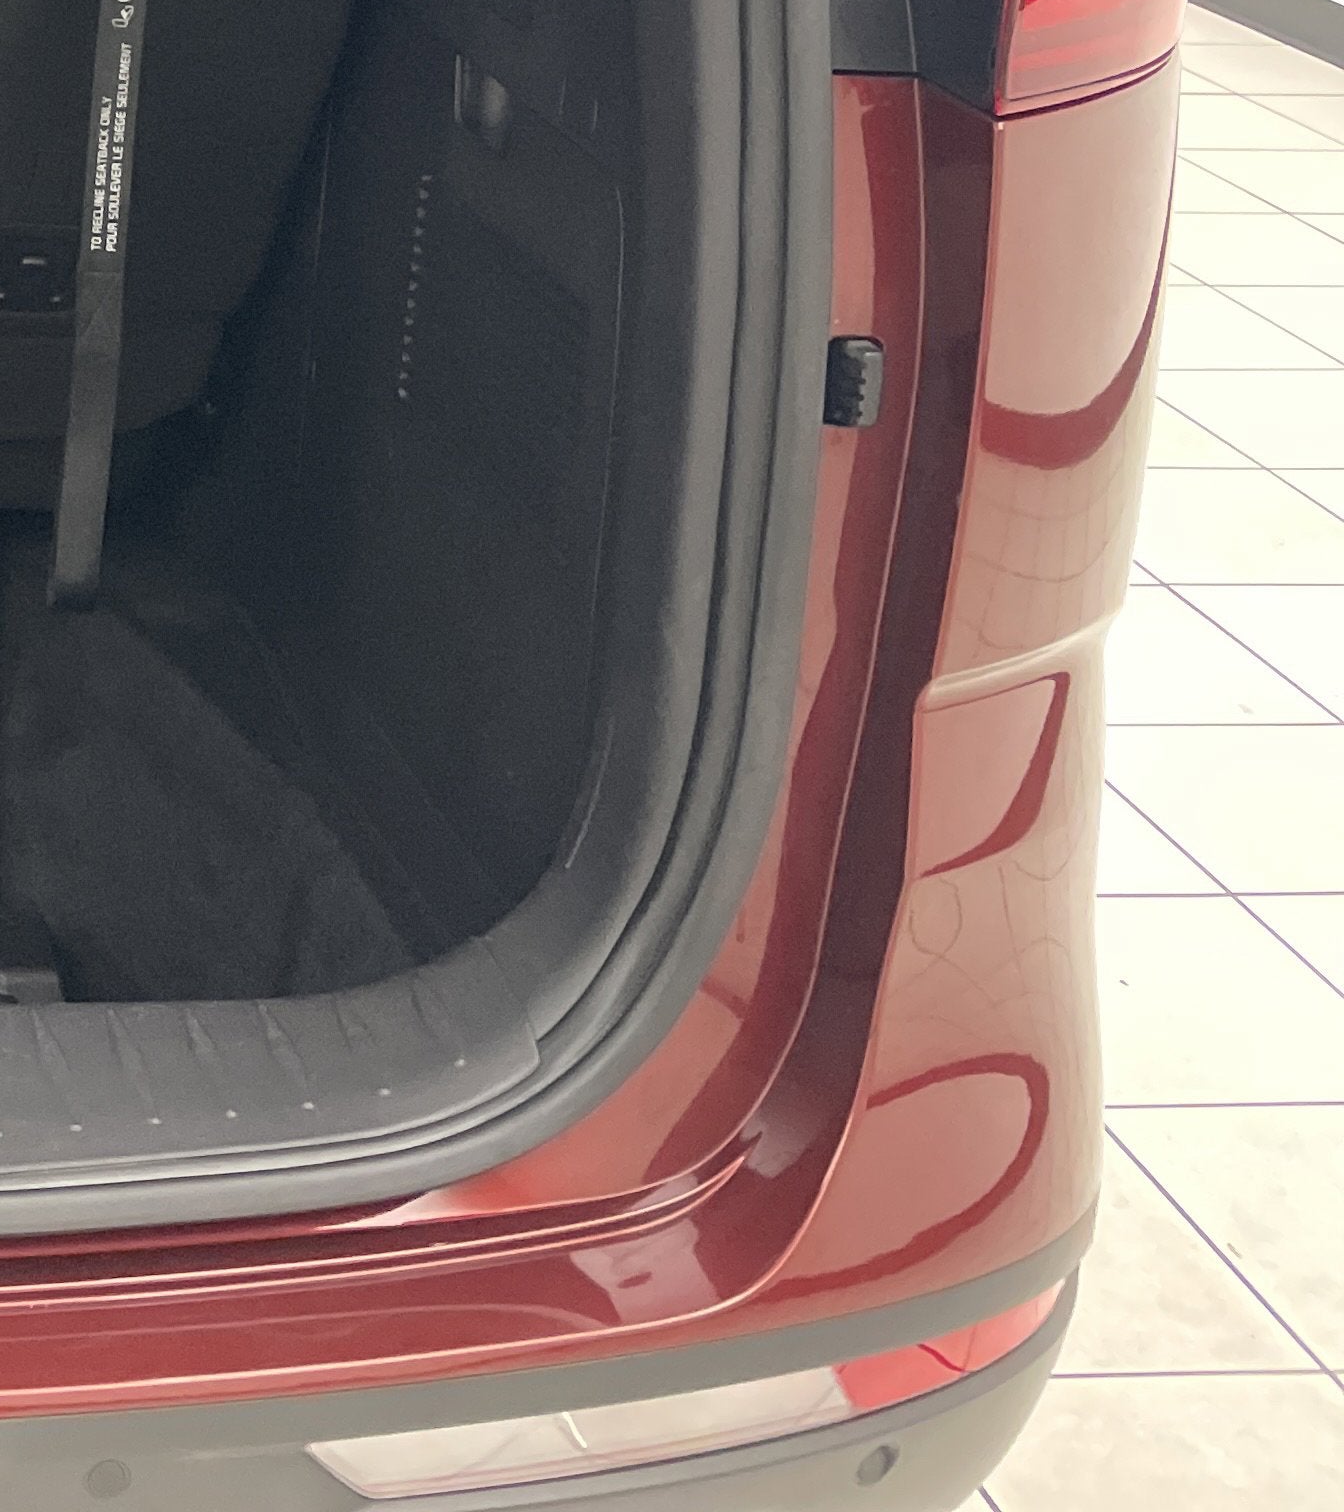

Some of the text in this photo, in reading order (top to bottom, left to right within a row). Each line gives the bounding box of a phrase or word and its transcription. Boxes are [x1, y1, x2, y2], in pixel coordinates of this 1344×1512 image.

[116, 42, 133, 108] SEULEMENT
[90, 95, 112, 251] TO RECLINE SEATBACK ONLY
[112, 146, 124, 160] LE
[107, 162, 122, 220] SOULEVER
[105, 223, 118, 252] POUR
